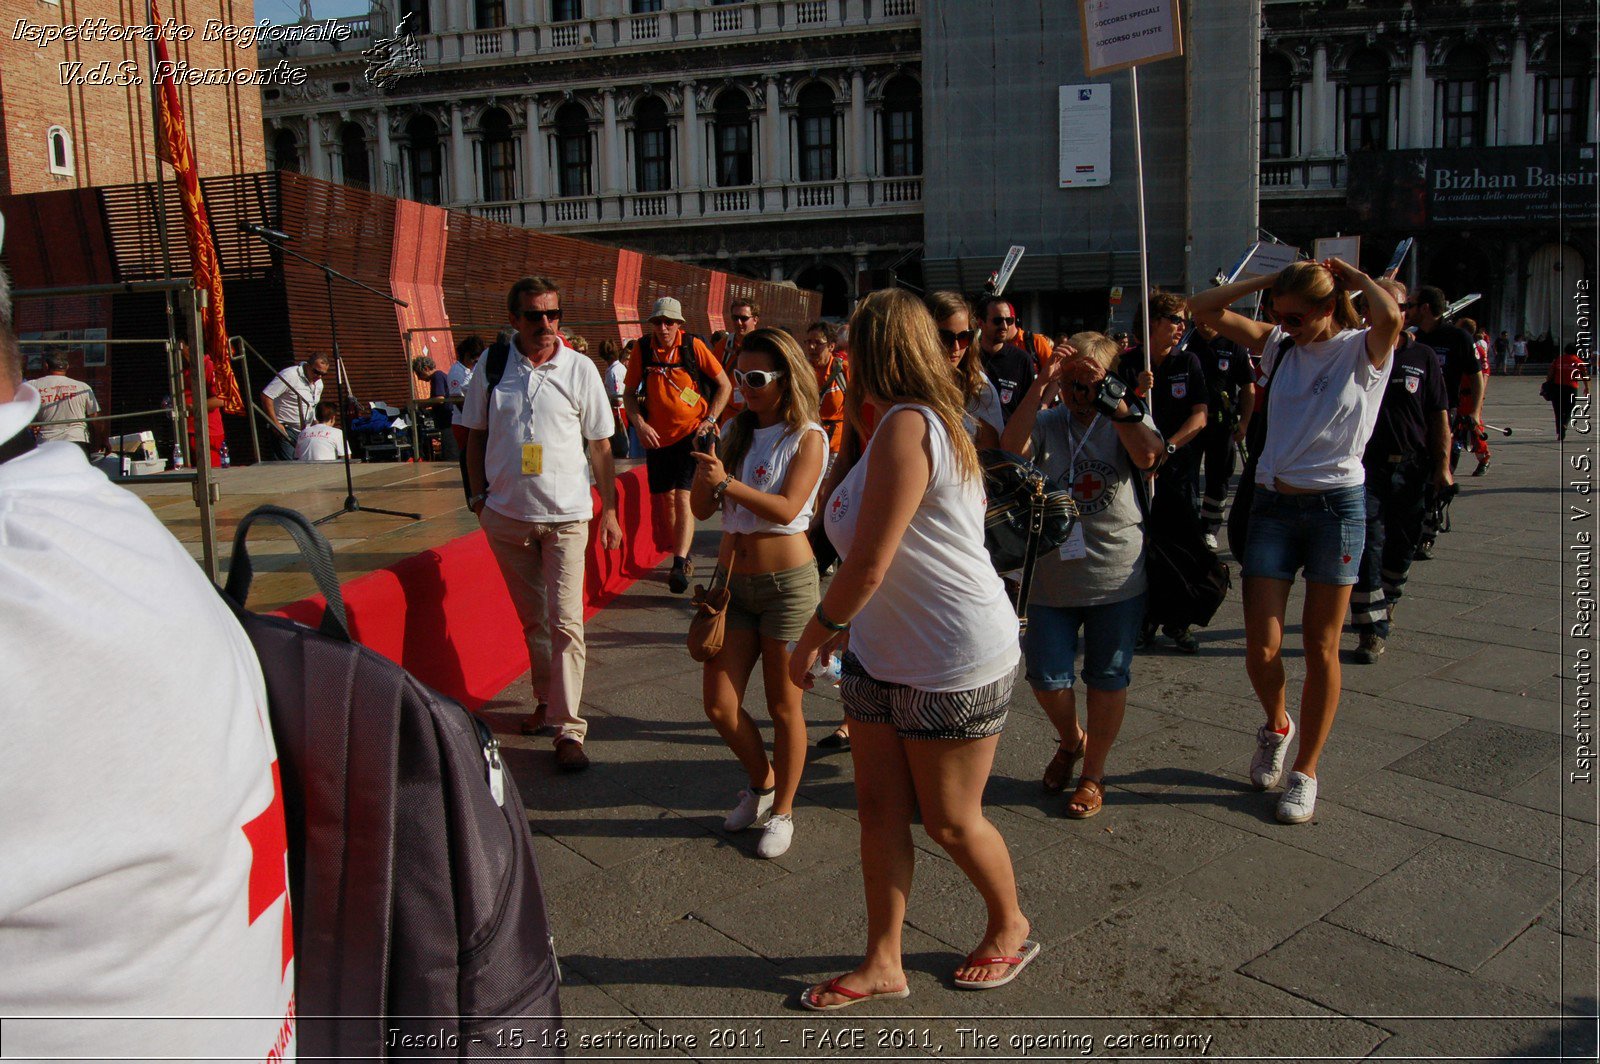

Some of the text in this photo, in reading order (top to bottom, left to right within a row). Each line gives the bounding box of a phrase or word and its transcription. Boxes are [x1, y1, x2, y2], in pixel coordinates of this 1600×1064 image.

[1094, 6, 1160, 28] SOCCORSI SPECIALI
[1096, 26, 1162, 47] SOCCORSO SU PISTE
[1434, 168, 1517, 190] Bizhan
[1433, 190, 1550, 201] La caduta delle meteoriti
[41, 392, 77, 404] STAFF
